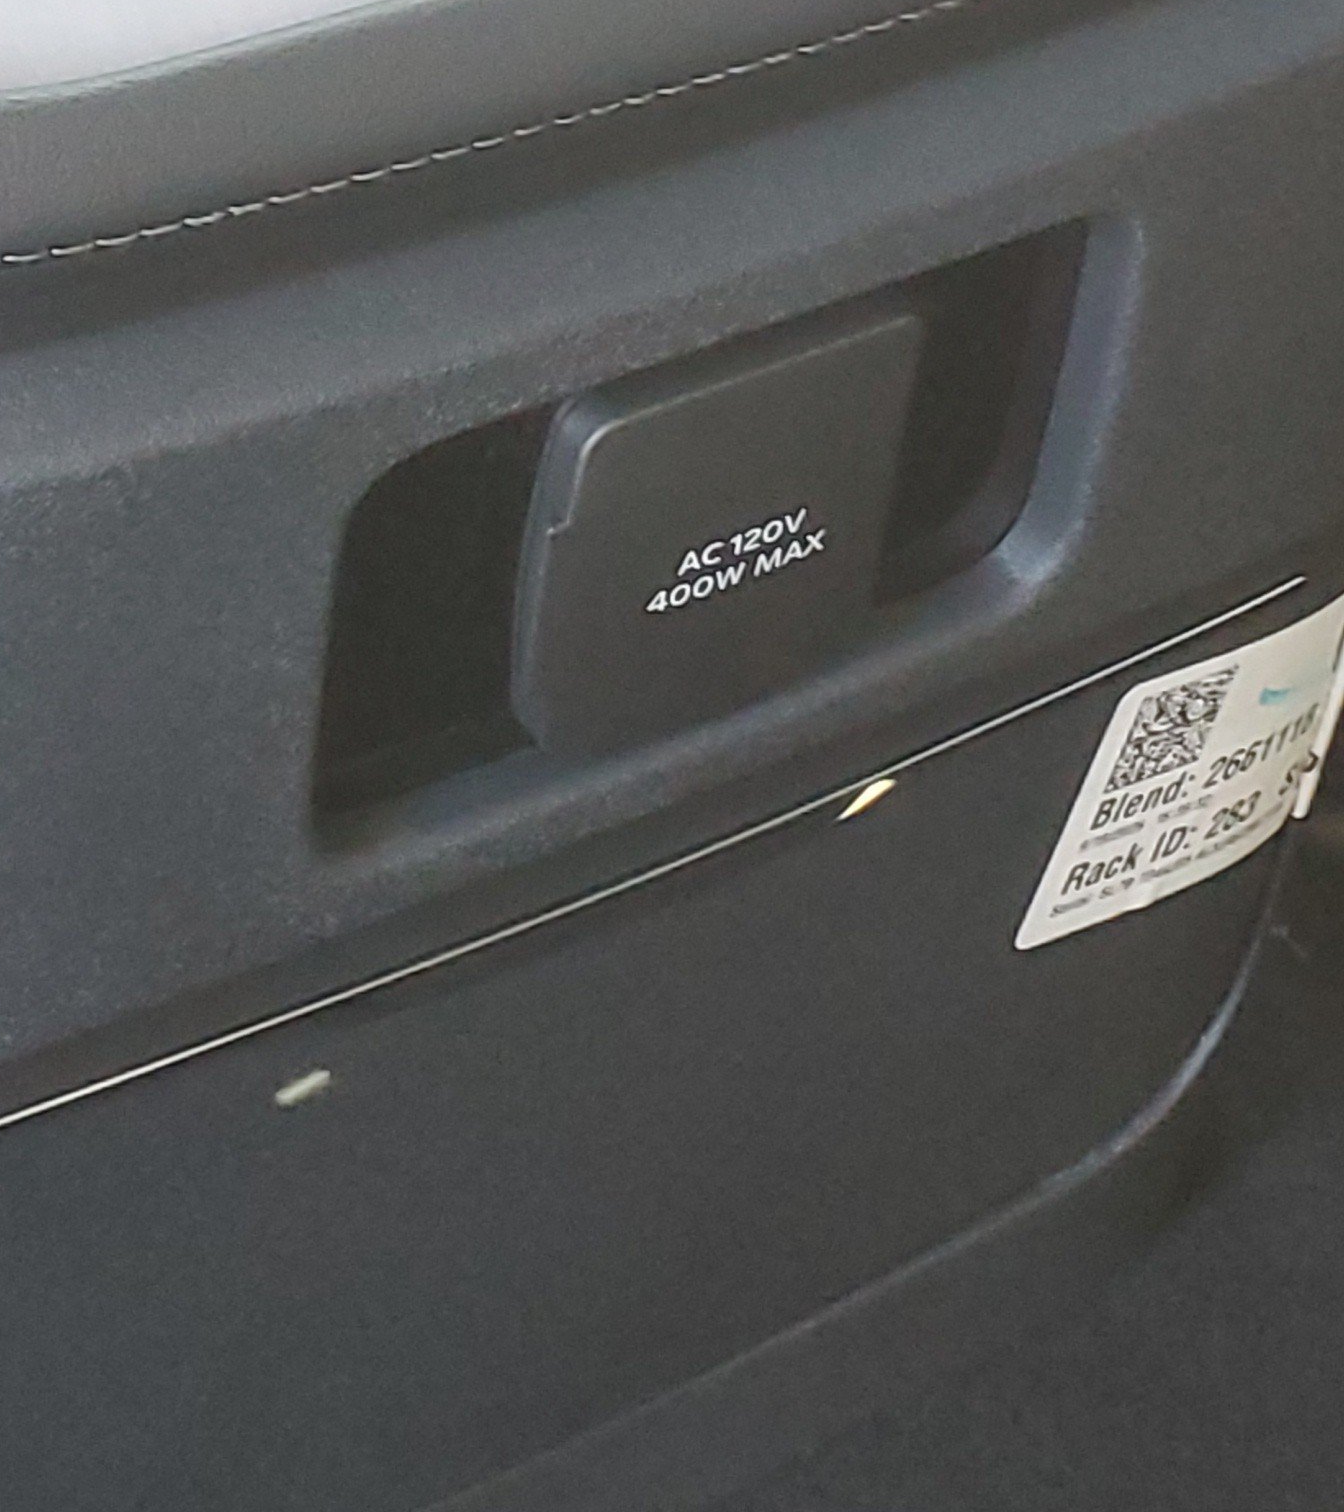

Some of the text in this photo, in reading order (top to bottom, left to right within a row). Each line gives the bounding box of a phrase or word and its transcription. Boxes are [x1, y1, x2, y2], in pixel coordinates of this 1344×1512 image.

[645, 528, 827, 613] 400W MAX
[677, 506, 808, 578] AC 120V
[1090, 770, 1197, 831] Blend:
[1060, 842, 1144, 896] Rack
[1150, 825, 1198, 863] ID:
